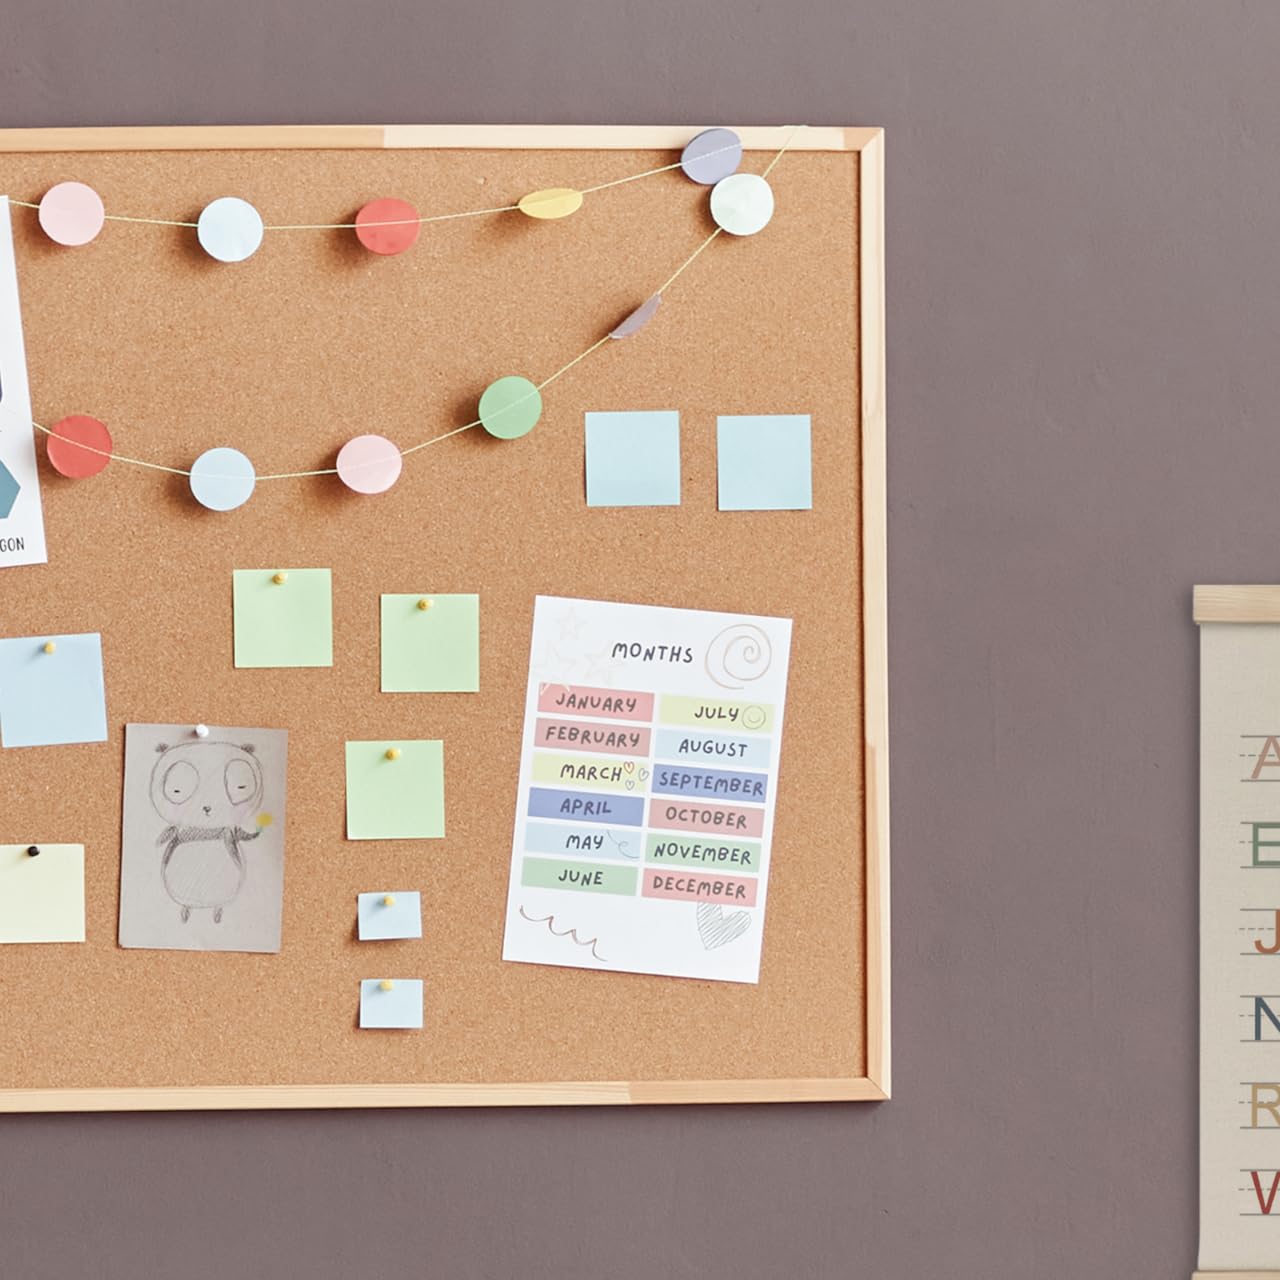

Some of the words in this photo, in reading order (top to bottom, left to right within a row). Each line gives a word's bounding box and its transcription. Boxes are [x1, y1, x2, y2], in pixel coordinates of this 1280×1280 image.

[611, 641, 694, 664] MONTHS
[554, 692, 637, 714] JANUARY
[693, 705, 740, 722] JULY
[545, 725, 641, 748] FEBRUARY
[677, 738, 749, 758] AUGUST
[559, 763, 623, 783] MARCH
[658, 772, 764, 797] SEPTEMBER
[559, 798, 613, 815] APRIL
[665, 806, 748, 829] OCTOBER
[565, 834, 605, 850] MAY
[653, 842, 753, 866] NOVEMBER
[557, 868, 604, 886] JUNE
[652, 875, 747, 900] DECEMBER
